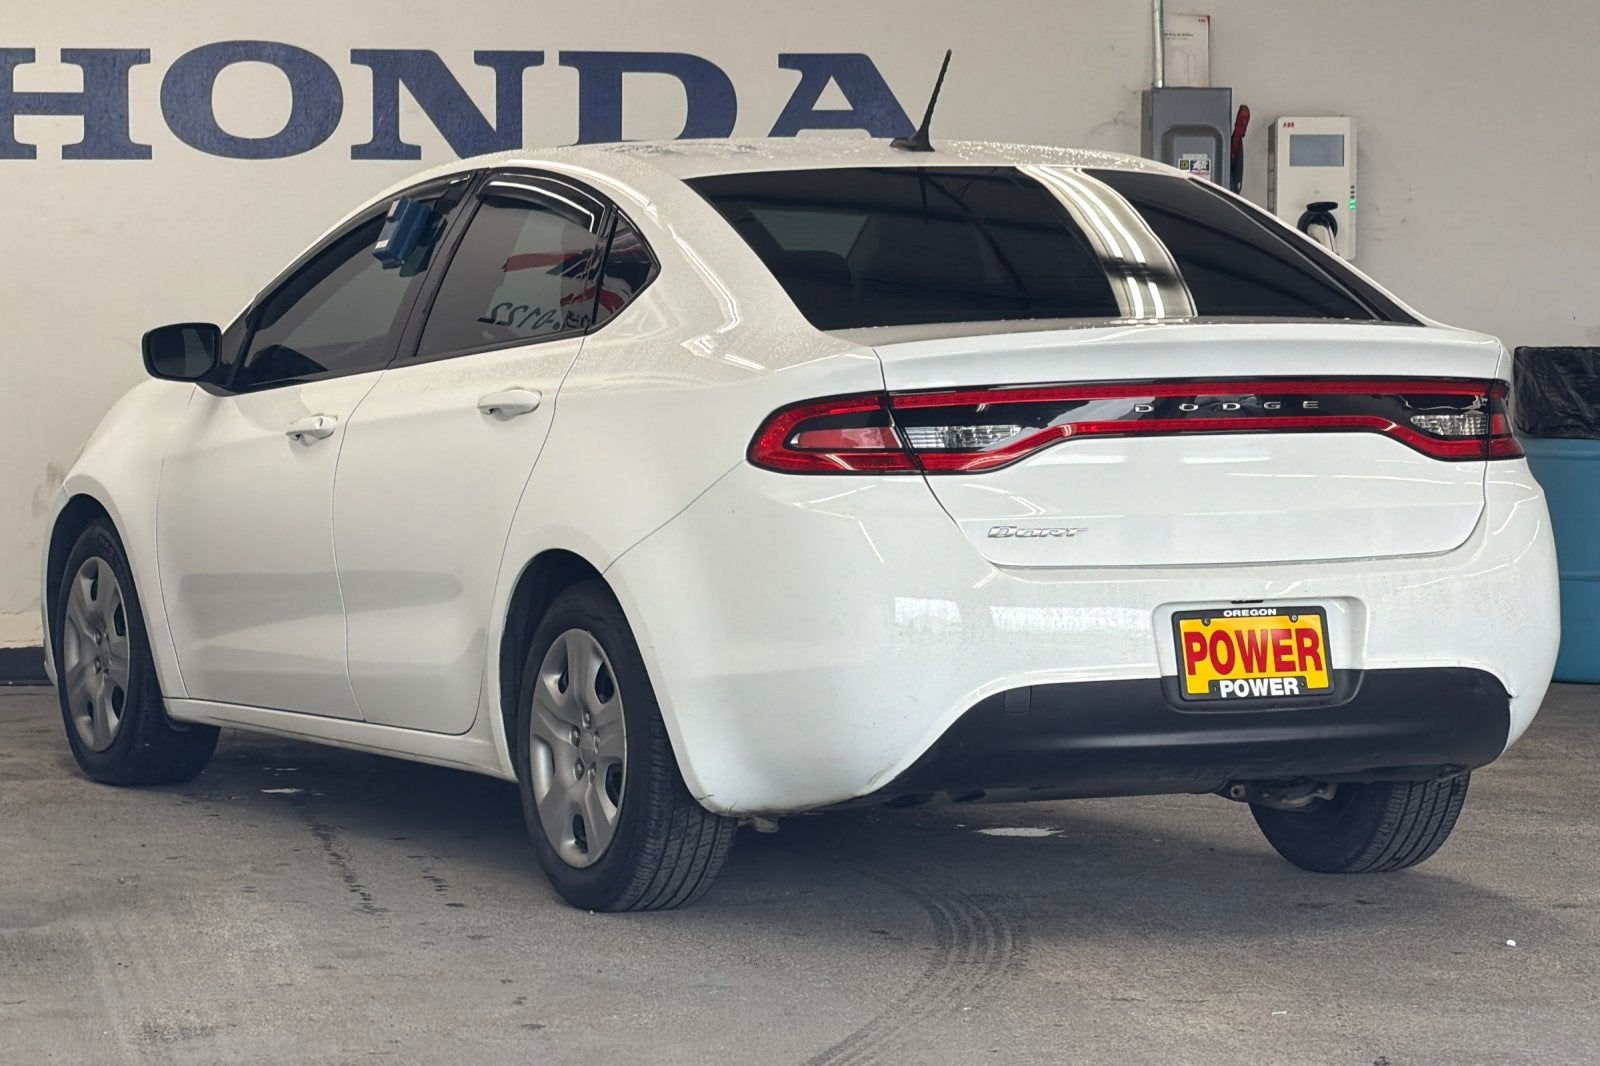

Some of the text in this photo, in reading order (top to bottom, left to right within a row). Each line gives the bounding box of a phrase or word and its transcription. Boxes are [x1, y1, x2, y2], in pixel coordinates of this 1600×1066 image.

[0, 40, 922, 160] HONDA
[1135, 401, 1318, 413] DODGE
[1223, 608, 1277, 617] OREGON
[1183, 628, 1323, 676] POWER
[1219, 677, 1300, 699] POWER
